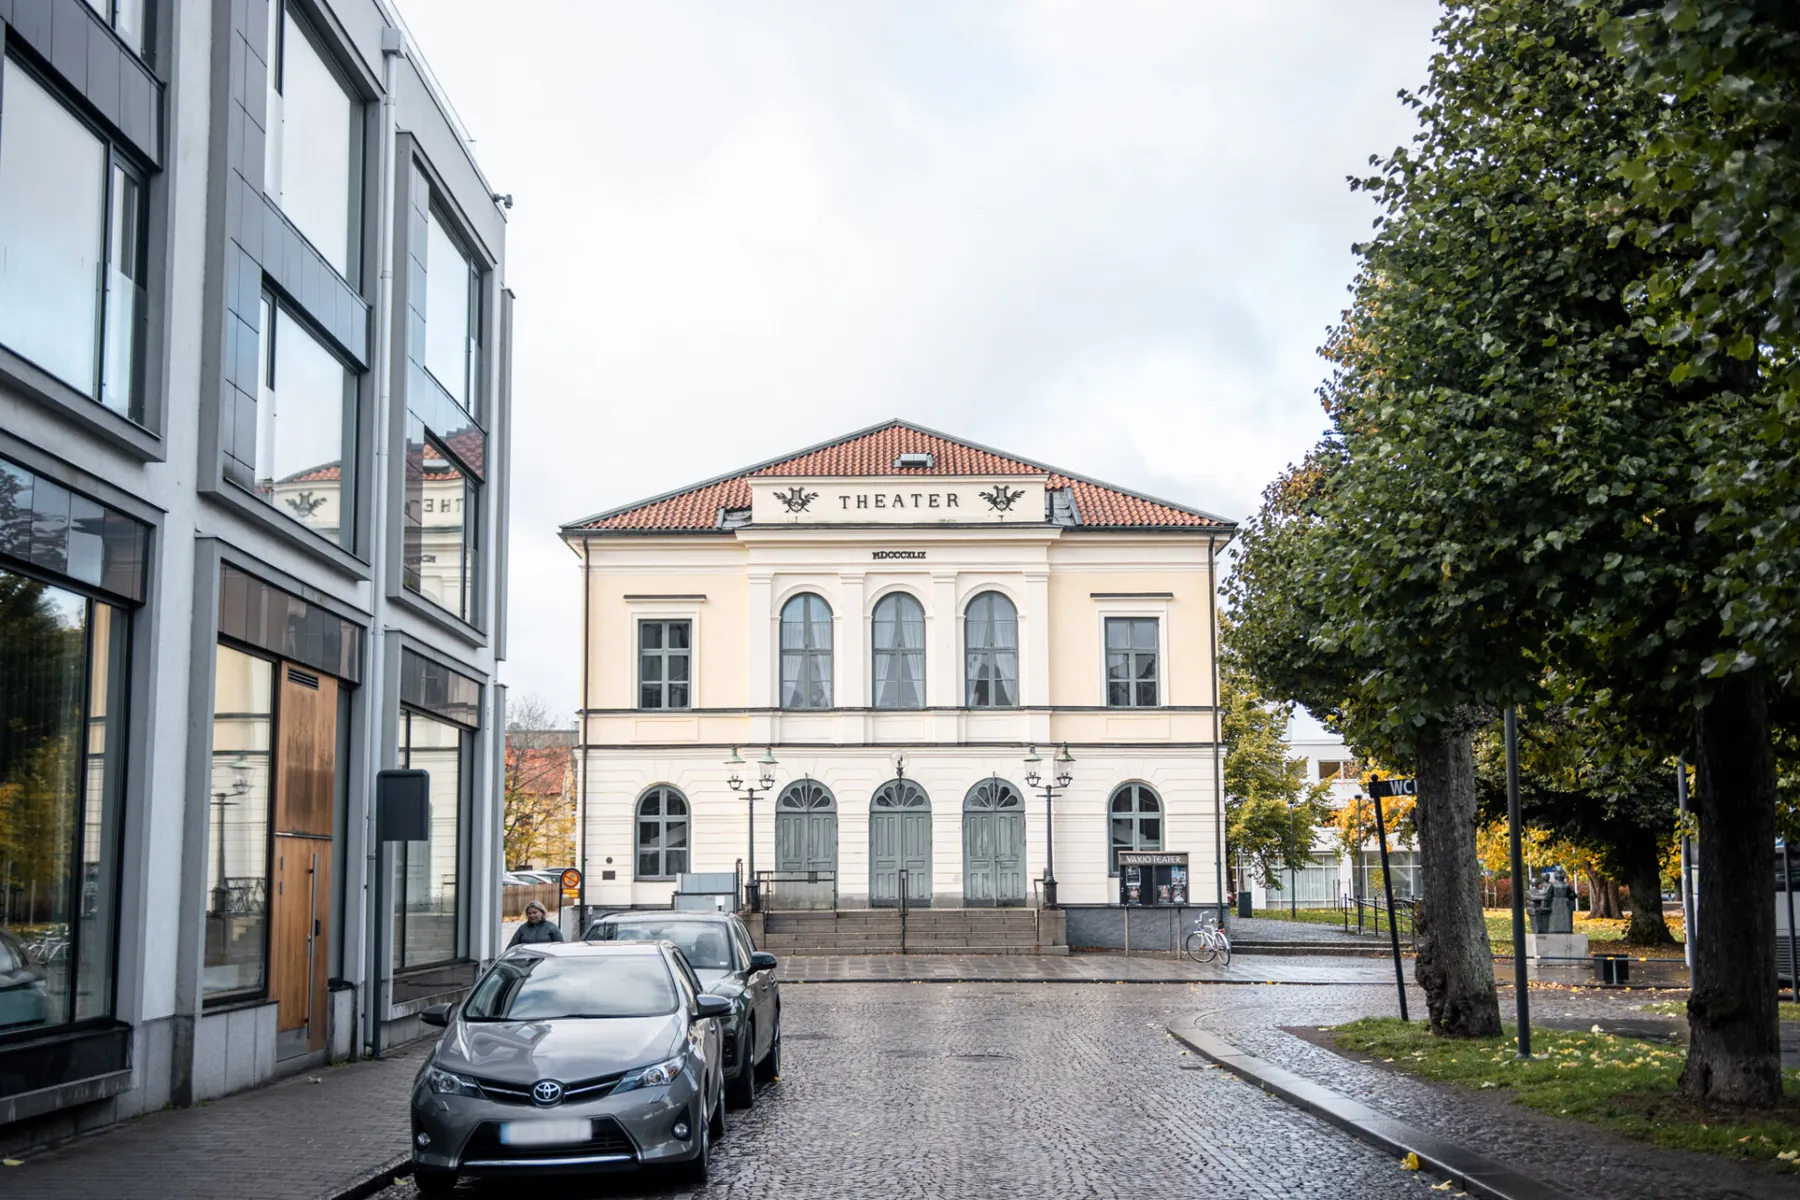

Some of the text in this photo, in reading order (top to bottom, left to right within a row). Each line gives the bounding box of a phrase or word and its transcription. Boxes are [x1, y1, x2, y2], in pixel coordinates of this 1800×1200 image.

[839, 493, 959, 509] THEATER
[872, 551, 926, 560] MDCCCXLIX
[1152, 855, 1181, 864] TEATER
